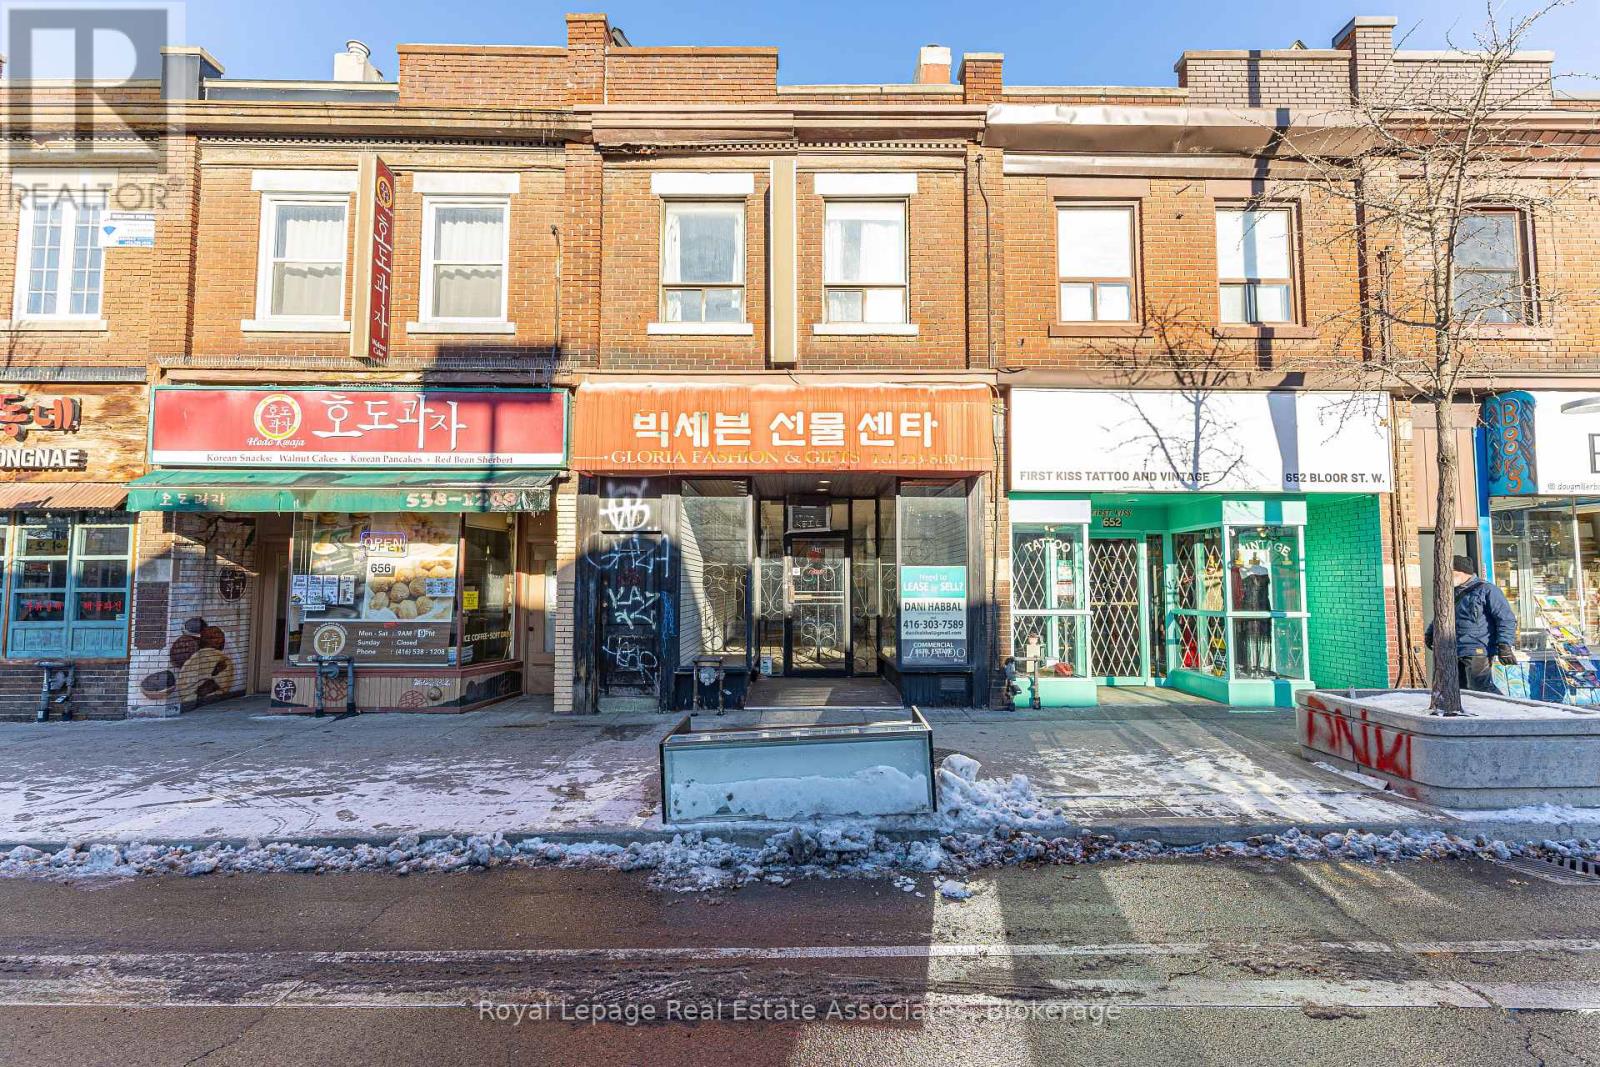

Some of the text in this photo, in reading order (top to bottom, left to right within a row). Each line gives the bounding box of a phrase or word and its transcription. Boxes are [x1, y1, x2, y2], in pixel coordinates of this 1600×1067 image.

[373, 214, 393, 339] 호도과자
[312, 393, 468, 452] 호도과자
[632, 411, 939, 448] 빅세븐 선물 센타
[1501, 401, 1525, 494] BOOKS
[206, 453, 237, 462] Korean
[279, 453, 310, 463] Walnut
[311, 454, 339, 463] Cakes
[350, 454, 381, 464] Korean
[383, 455, 423, 464] Pancakes
[435, 455, 451, 464] Red
[454, 455, 474, 464] Bean
[476, 455, 513, 464] Sherbert
[611, 450, 686, 464] GLORIA
[692, 451, 780, 464] FASHION
[784, 451, 801, 464] &
[1020, 471, 1210, 481] FIRST KISS TATTOO AND VINTAGE
[1285, 473, 1385, 483] 652 BLOOR ST. W.
[1103, 517, 1122, 527] 652
[364, 537, 403, 550] OPEN
[1025, 537, 1071, 553] TATTOO
[370, 563, 391, 573] 656
[903, 582, 929, 591] LEASE
[940, 582, 964, 591] SELL?
[904, 602, 963, 611] DANI HABBAL
[903, 620, 964, 629] 416-303-7589
[358, 629, 373, 637] Mon
[378, 629, 389, 637] Sat
[471, 632, 488, 641] COFFEE
[357, 639, 381, 647] Sunday
[396, 648, 412, 656] (416)
